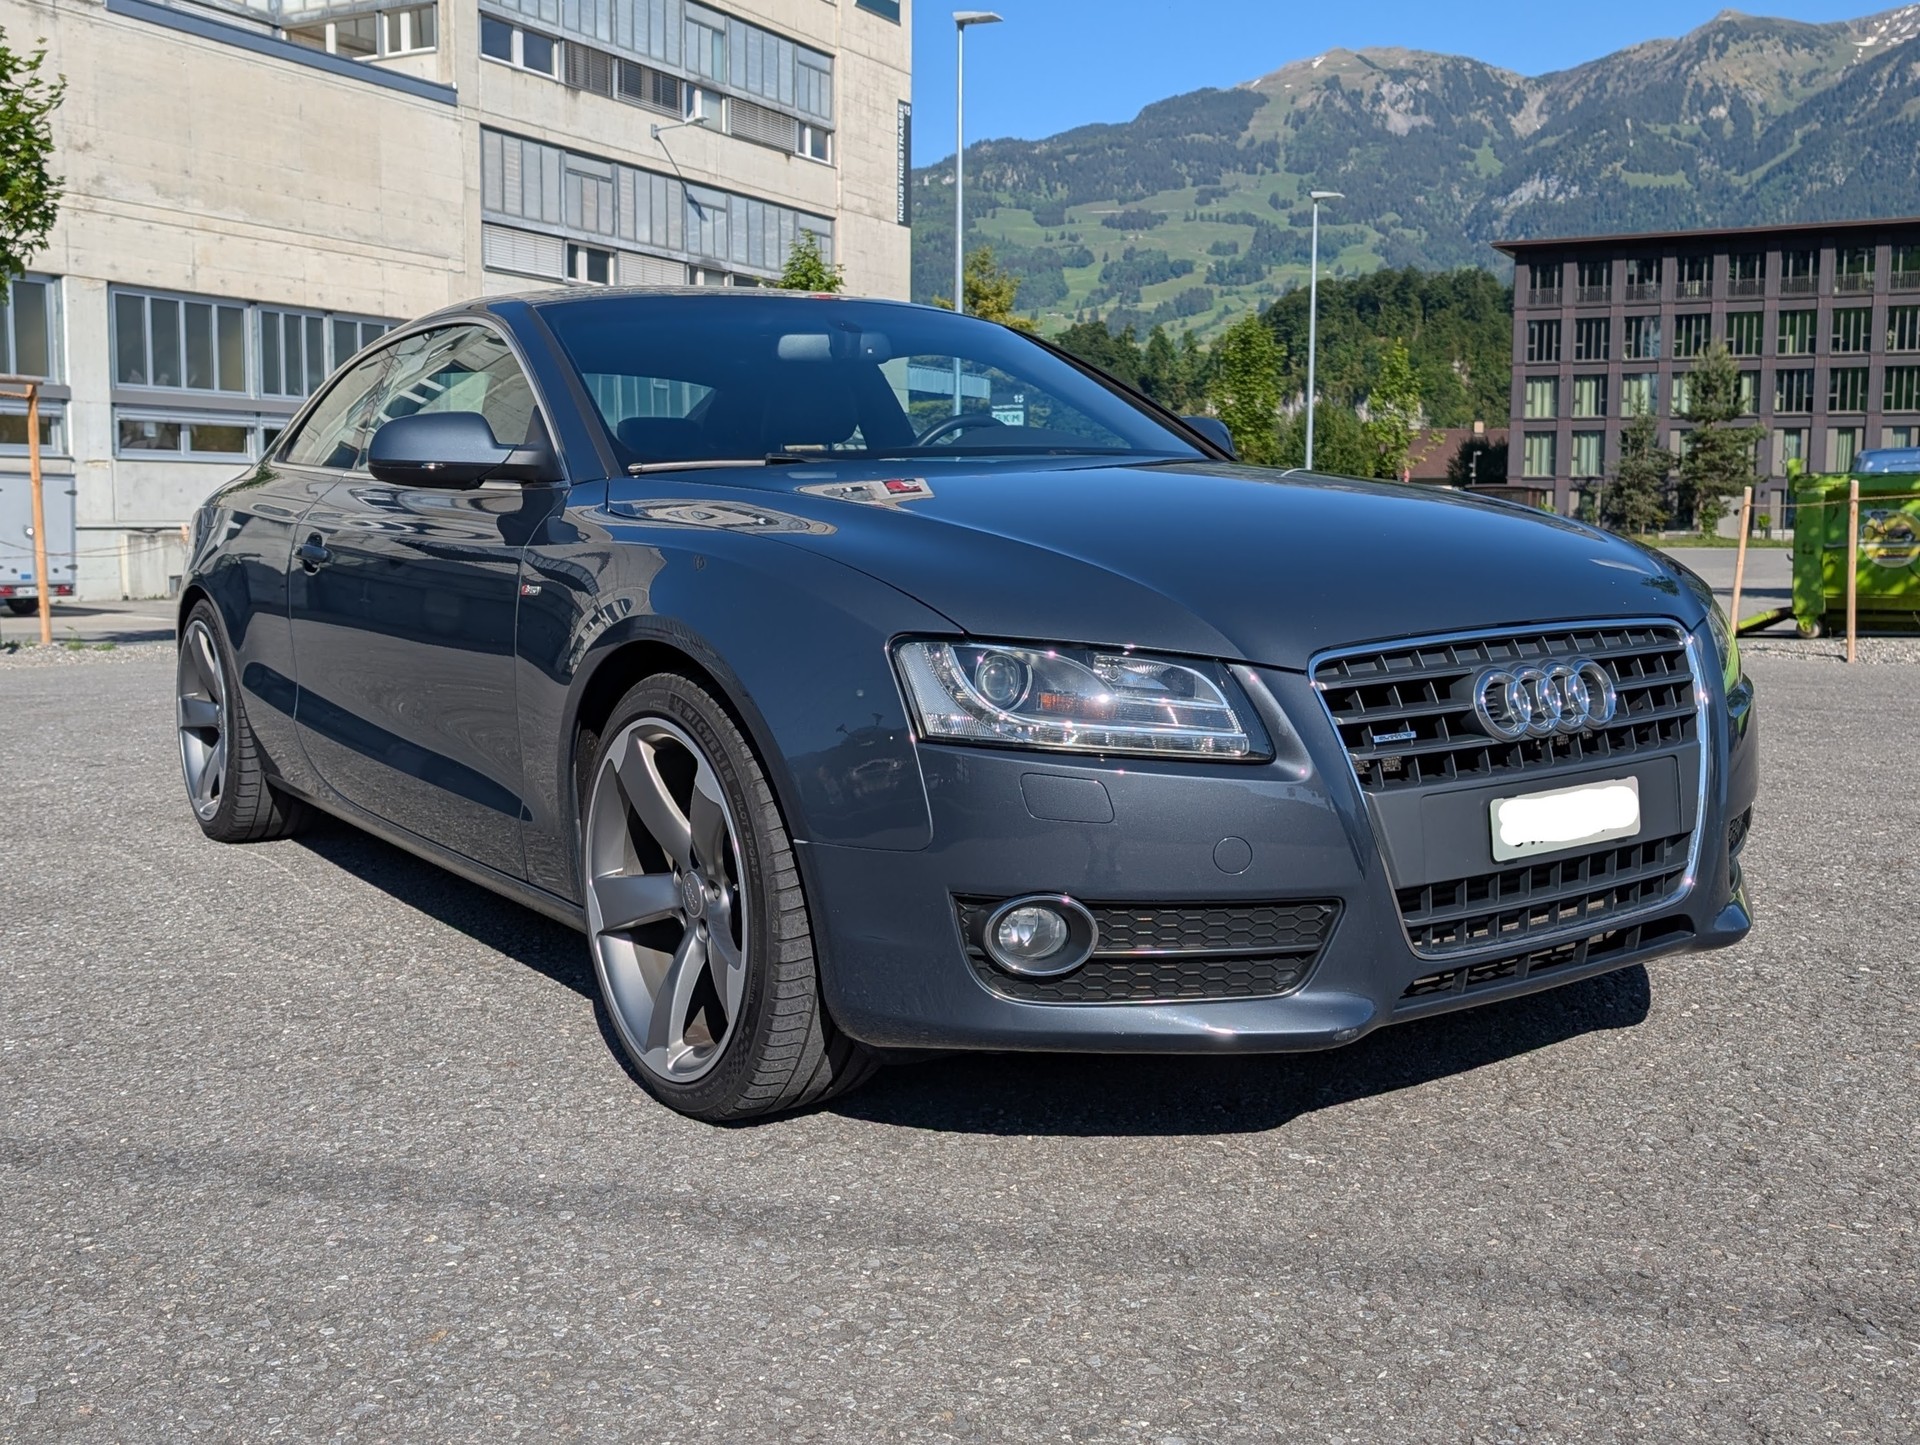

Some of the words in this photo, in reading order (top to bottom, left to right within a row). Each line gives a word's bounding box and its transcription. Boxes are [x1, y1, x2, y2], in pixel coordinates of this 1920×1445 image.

[904, 105, 911, 116] 15
[1013, 394, 1025, 403] 15
[682, 707, 736, 782] MICHELIN
[734, 794, 749, 826] PILOT
[744, 832, 759, 874] SPORT
